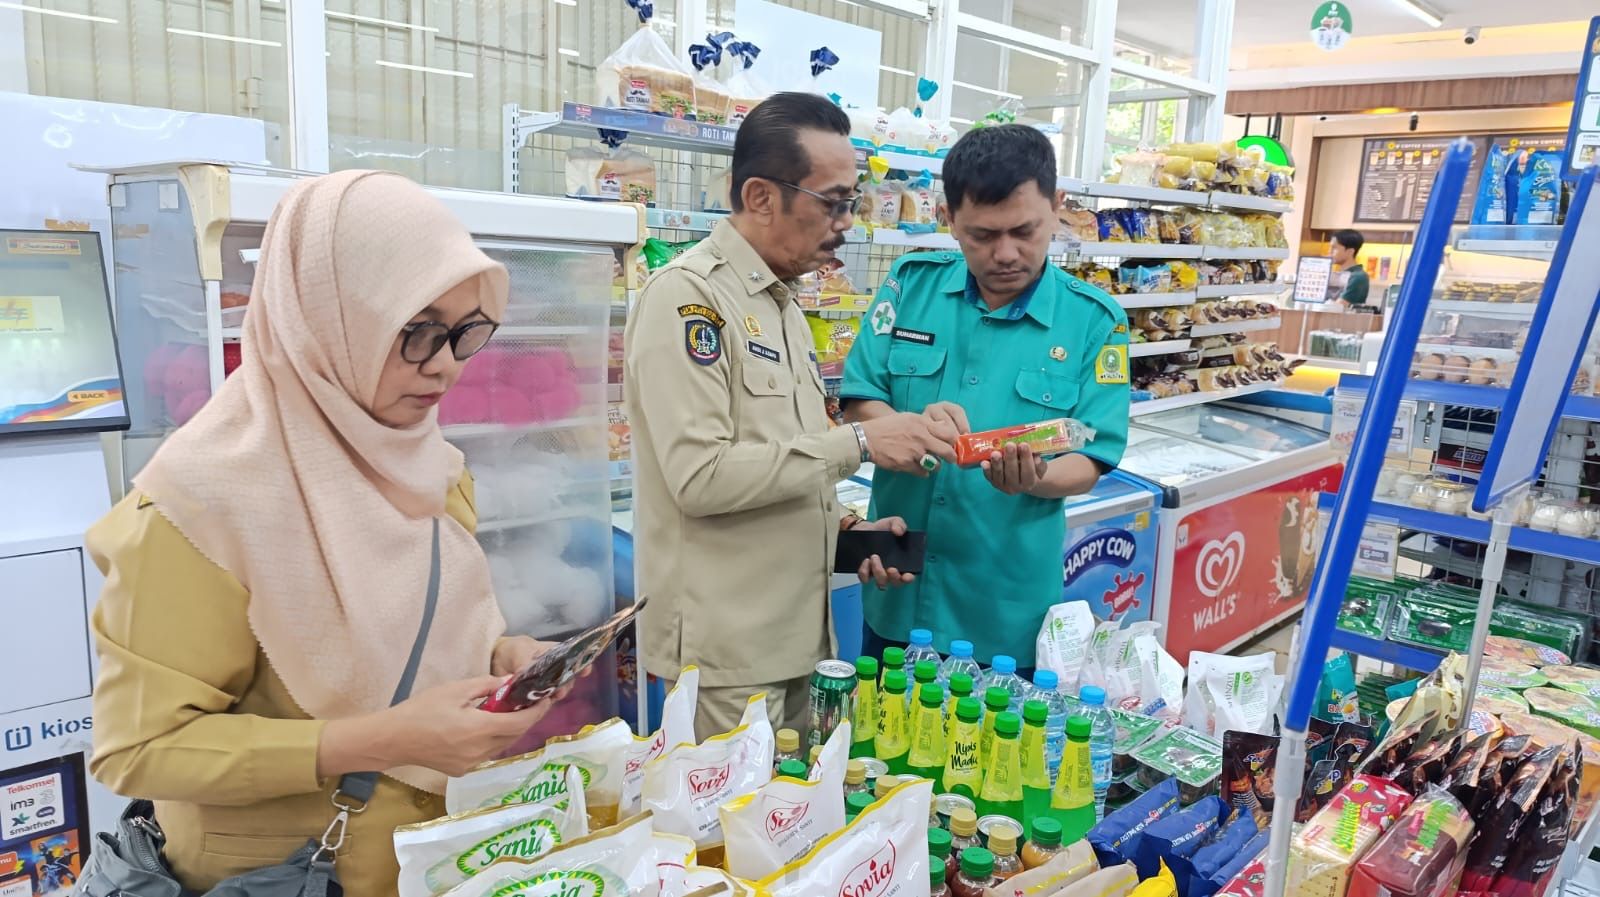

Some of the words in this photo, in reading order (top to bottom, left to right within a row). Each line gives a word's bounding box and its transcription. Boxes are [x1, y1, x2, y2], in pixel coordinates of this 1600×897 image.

[702, 127, 720, 139] ROTI
[1063, 538, 1105, 581] HAPPY
[1106, 537, 1135, 561] COW
[1193, 593, 1237, 633] WALL'S
[955, 741, 977, 756] Nipis
[951, 754, 978, 770] Madu
[7, 776, 56, 795] Telkomsel
[842, 859, 891, 897] Sovia
